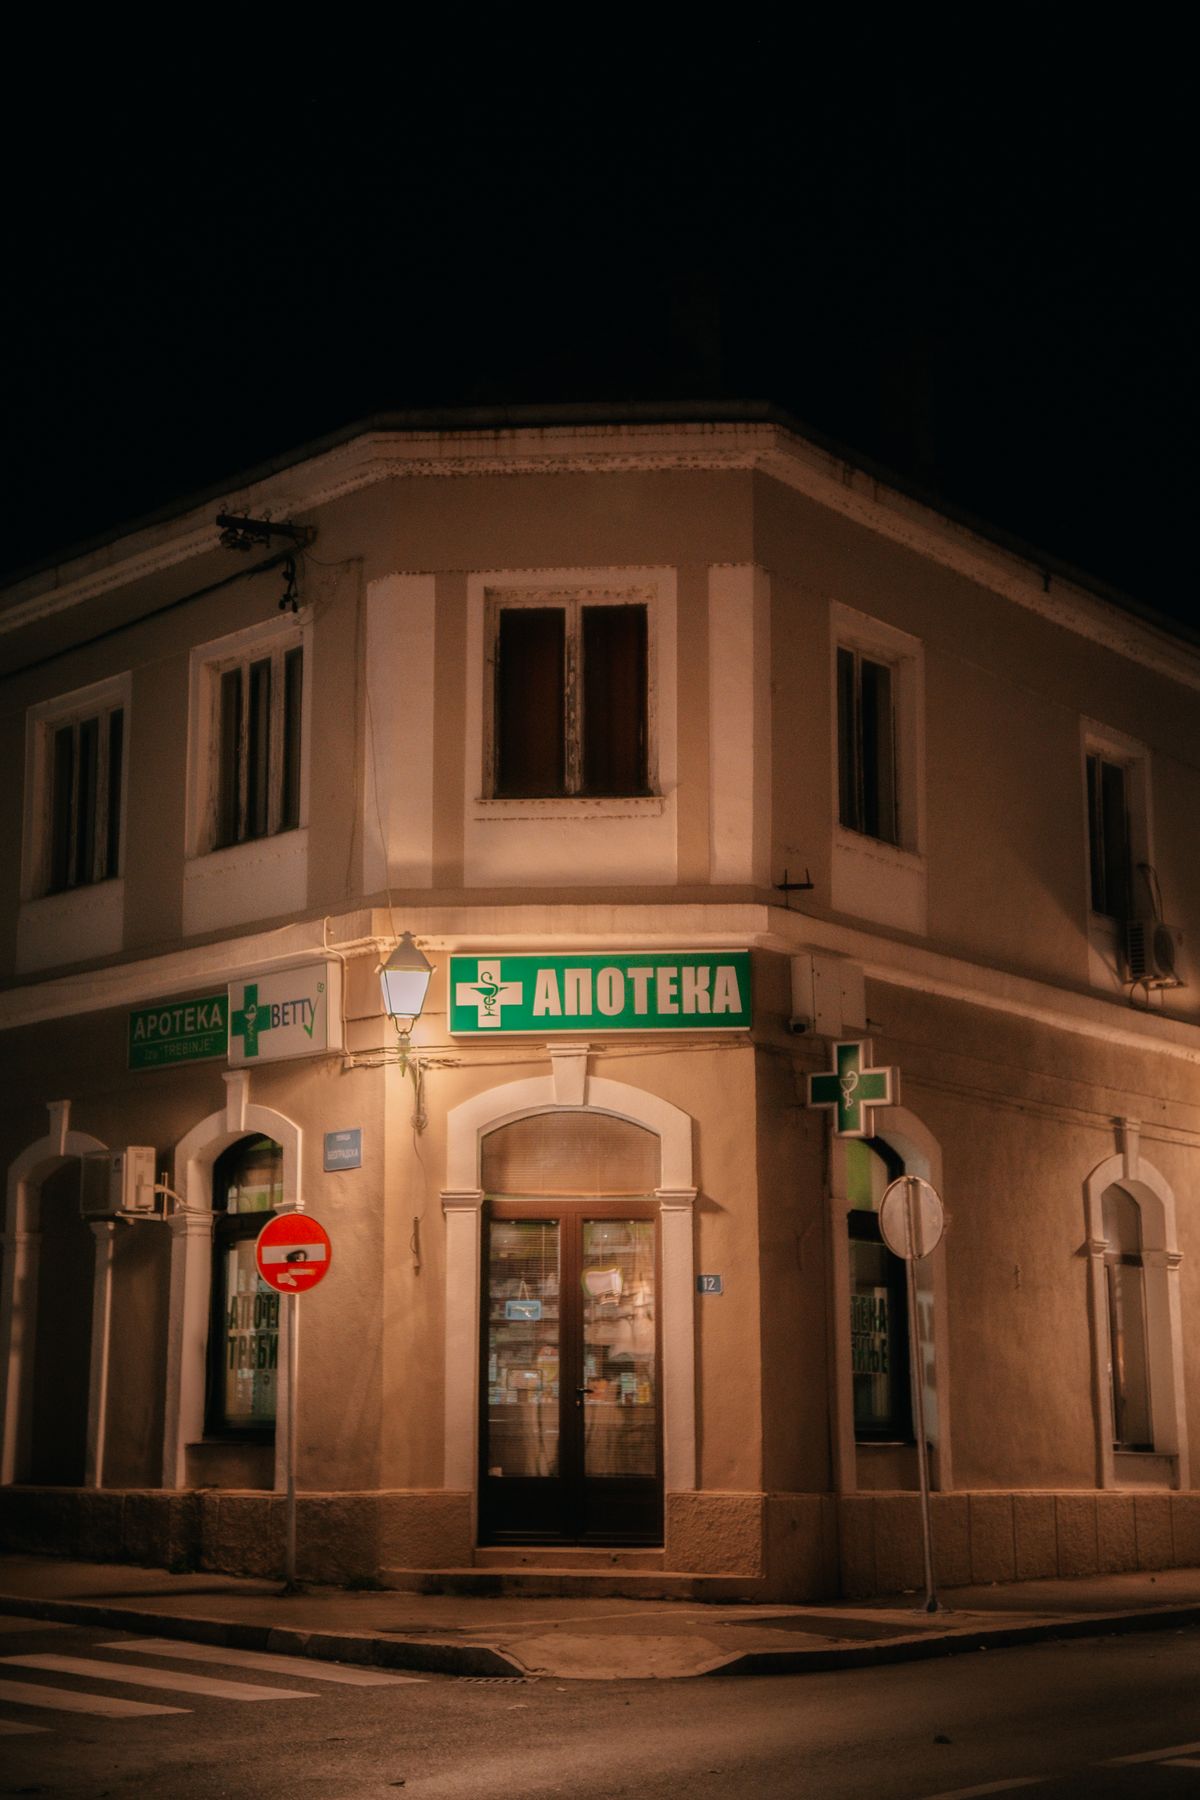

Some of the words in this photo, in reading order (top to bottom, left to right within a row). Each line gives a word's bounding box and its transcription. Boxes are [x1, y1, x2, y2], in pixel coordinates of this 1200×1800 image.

[533, 966, 742, 1016] АПОТЕКА
[134, 1003, 222, 1040] APOTEKA
[704, 1277, 716, 1291] 12
